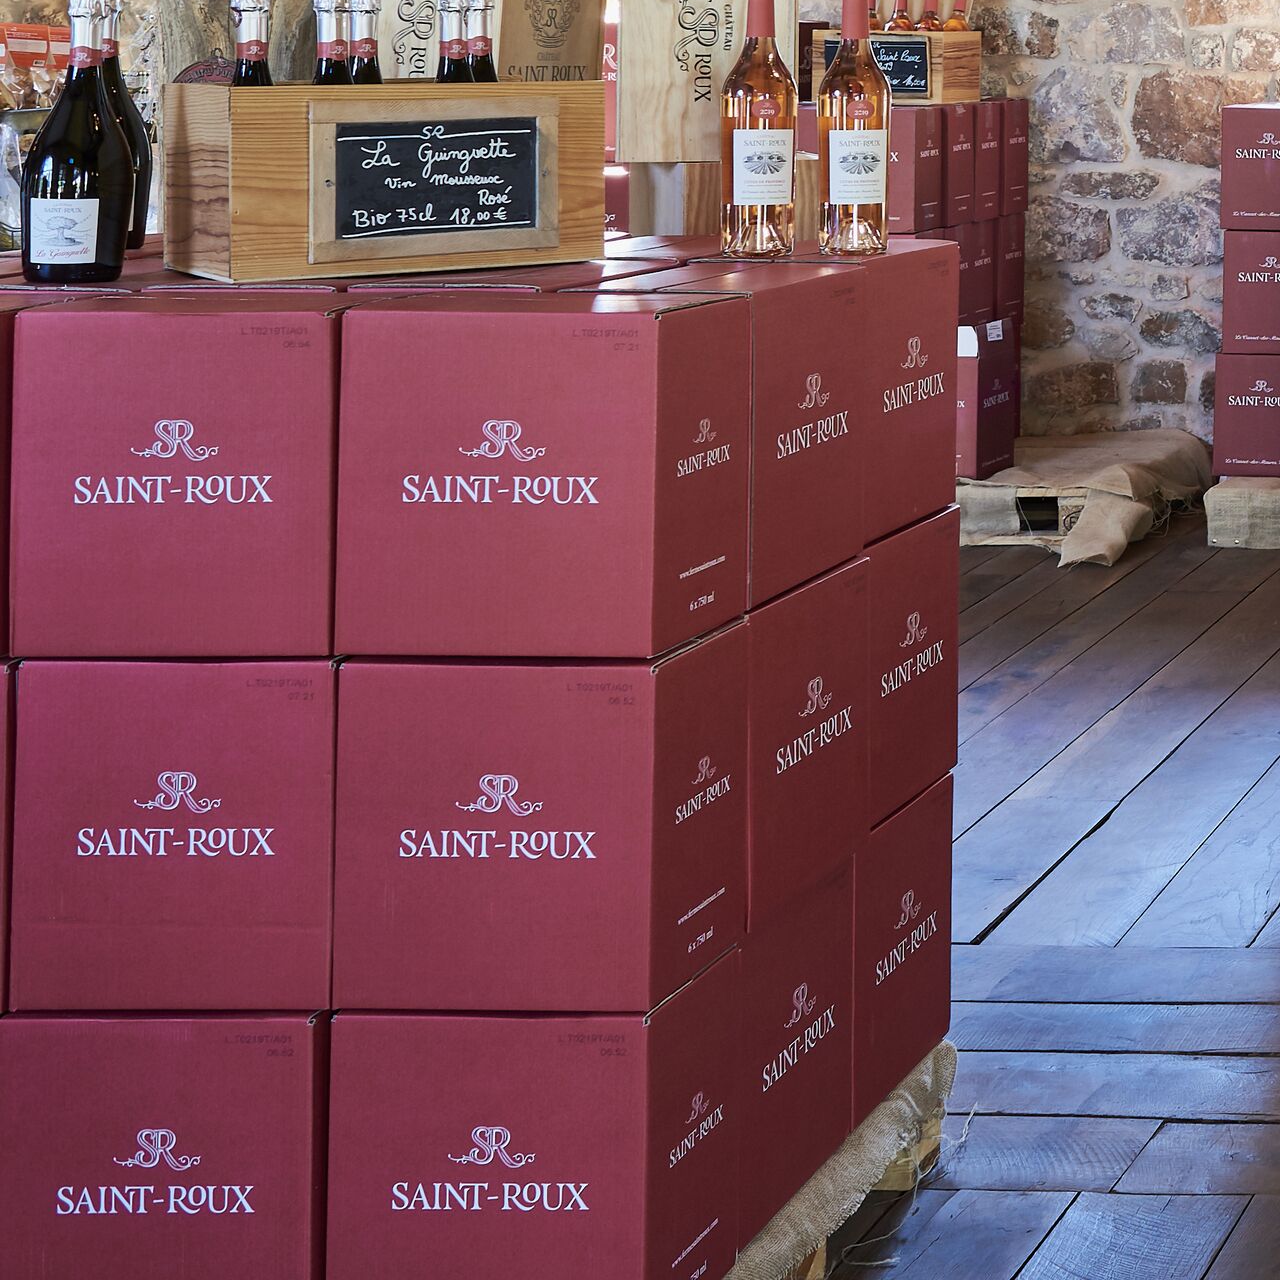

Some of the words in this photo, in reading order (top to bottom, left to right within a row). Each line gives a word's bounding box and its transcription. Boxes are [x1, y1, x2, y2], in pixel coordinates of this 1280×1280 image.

[723, 4, 733, 51] CHÂTEAU
[693, 51, 713, 103] ROUX
[361, 141, 400, 169] La
[418, 138, 516, 178] Guinguette
[352, 210, 392, 228] Bio
[396, 203, 436, 222] 75cl
[477, 186, 512, 206] Rosé
[883, 371, 945, 414] SAINT-ROUX
[776, 411, 849, 460] SAINT-ROUX
[677, 443, 731, 477] SAINT-ROUX
[74, 475, 273, 505] SAINT-ROUX
[401, 475, 599, 505] SAINT-ROUX
[881, 639, 944, 698] SAINT-ROUX
[775, 706, 852, 775] SAINT-ROUX
[675, 773, 731, 825] SAINT-ROUX
[77, 826, 276, 861] SAINT-ROUX
[398, 828, 597, 862] SAINT-ROUX
[874, 910, 938, 987] SAINT-ROUX
[761, 1004, 836, 1094] SAINT-ROUX
[668, 1103, 724, 1169] SAINT-ROUX
[56, 1184, 255, 1217] SAINT-ROUX
[391, 1181, 589, 1215] SAINT-ROUX
